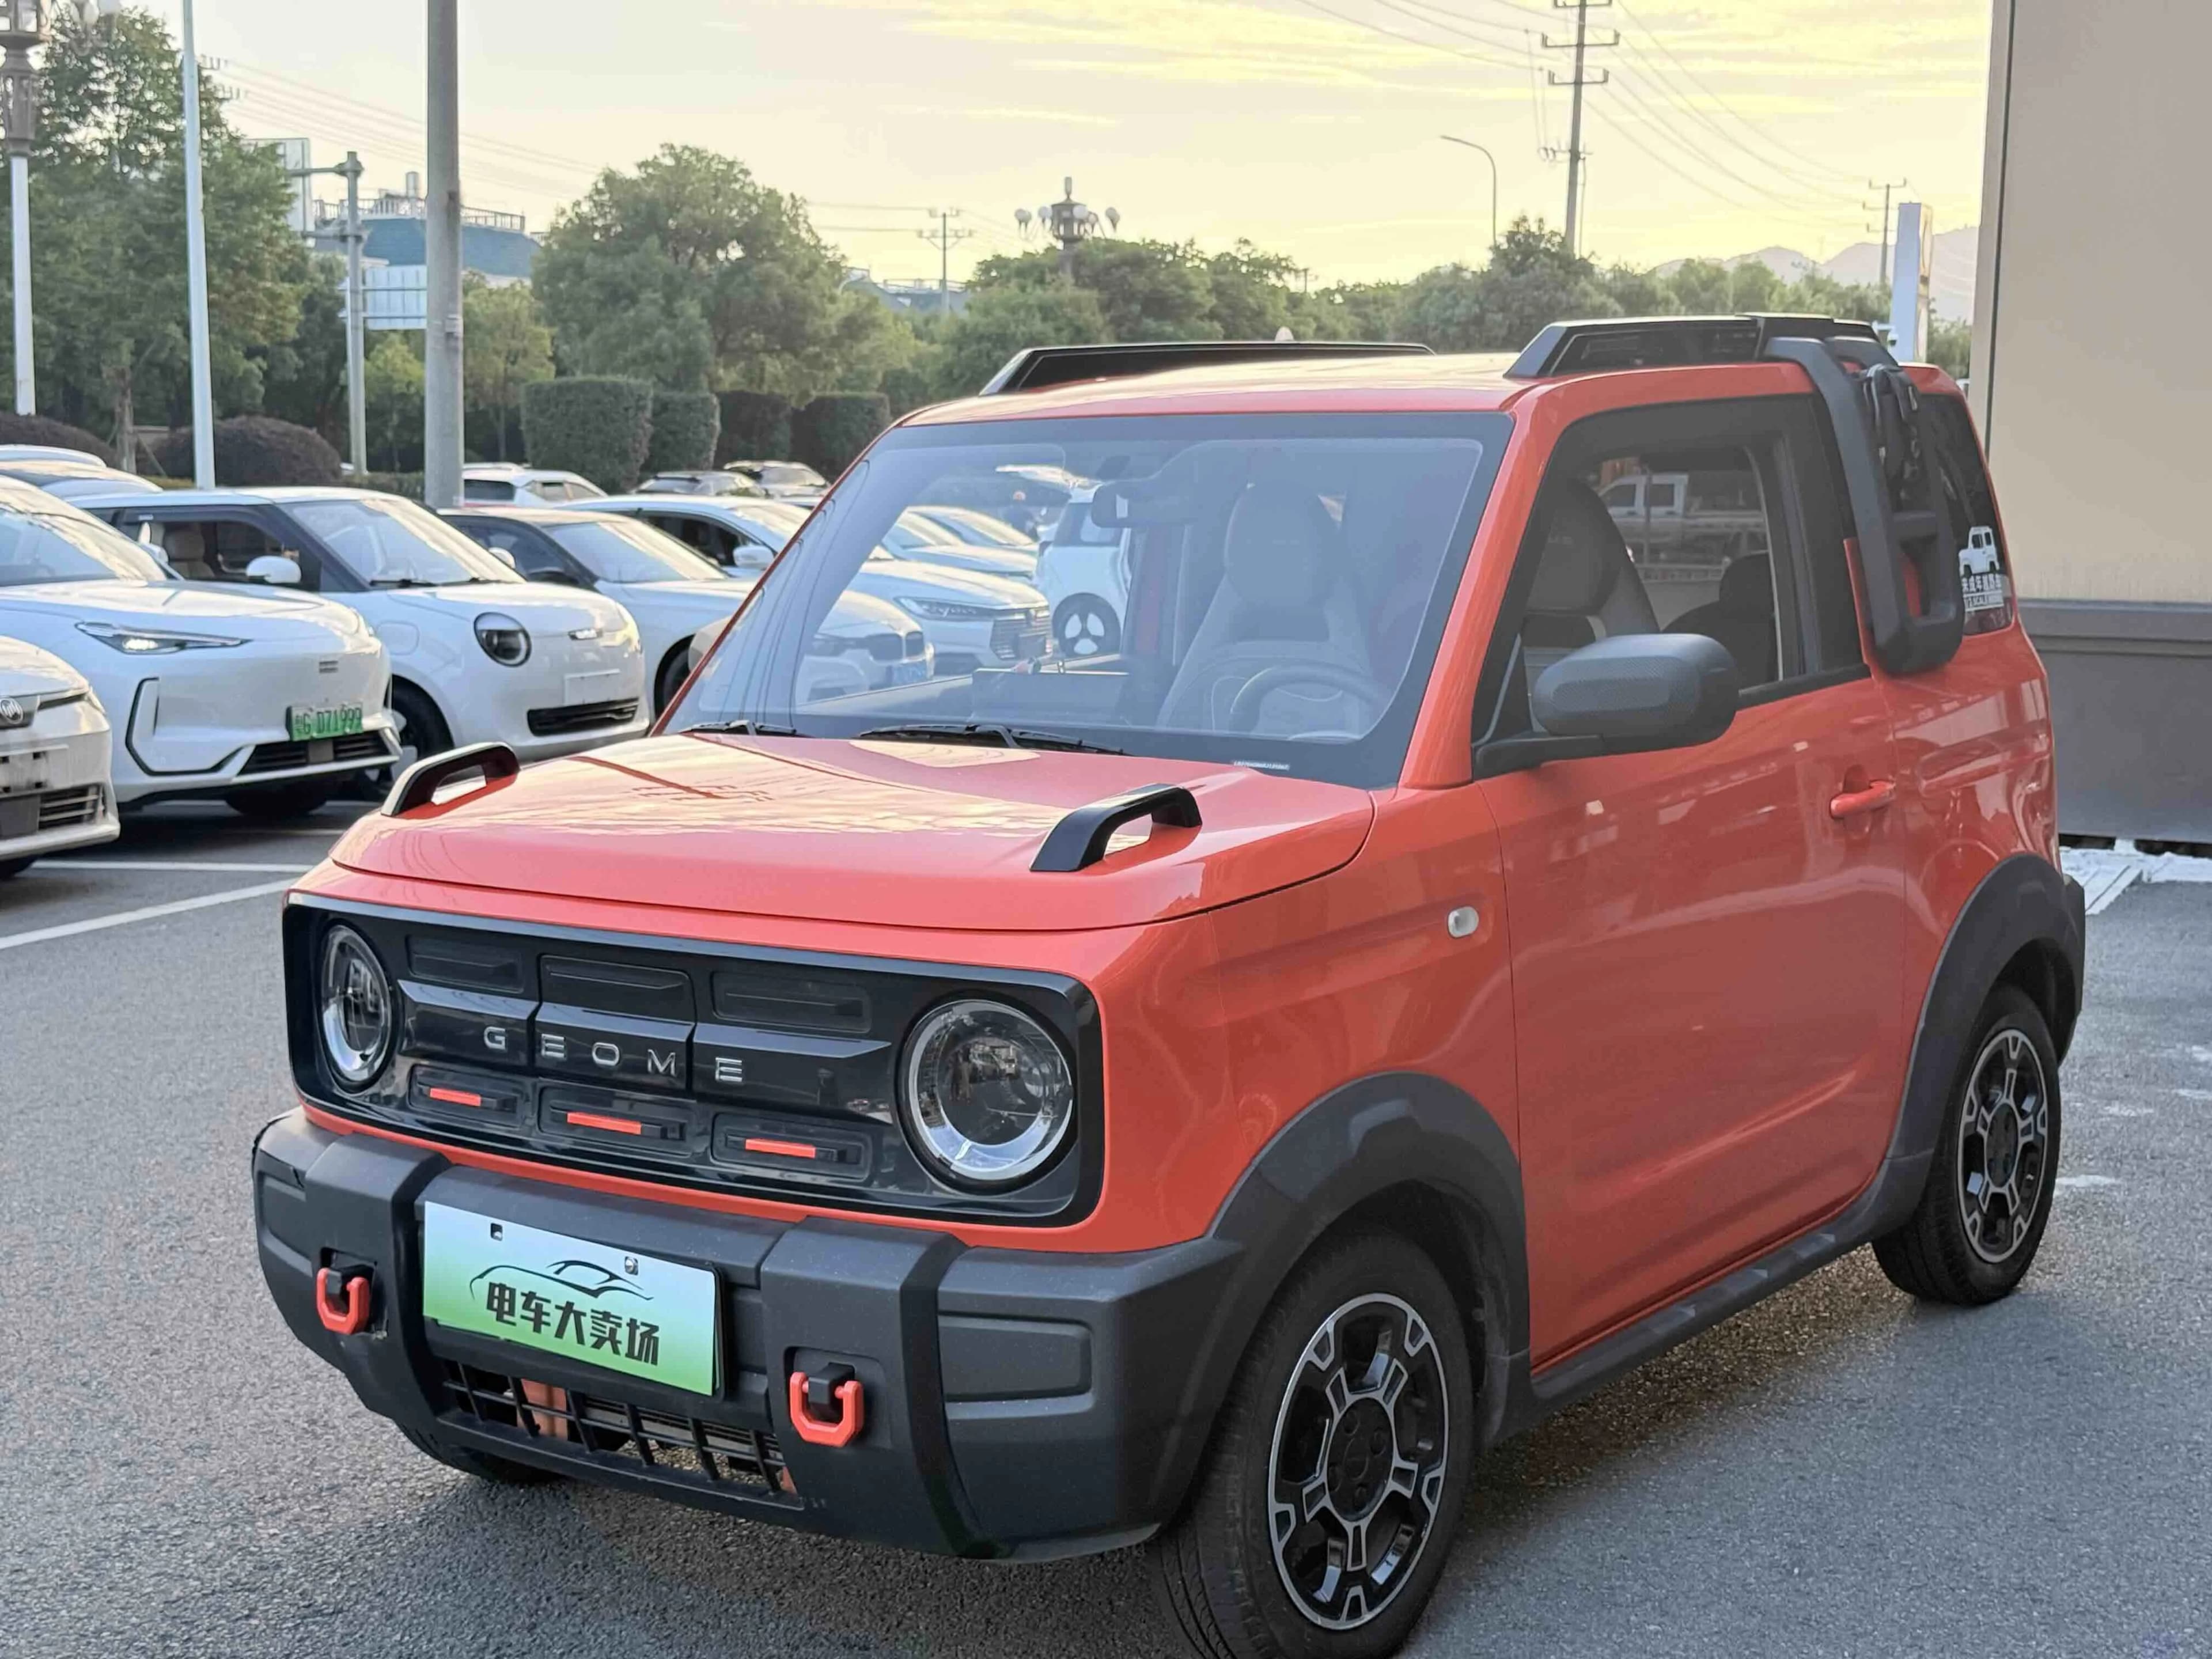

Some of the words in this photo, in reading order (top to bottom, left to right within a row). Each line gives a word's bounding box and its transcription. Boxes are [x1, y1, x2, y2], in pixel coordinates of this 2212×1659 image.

[483, 1026, 743, 1082] GEOME
[486, 1281, 660, 1366] 电车大卖场
